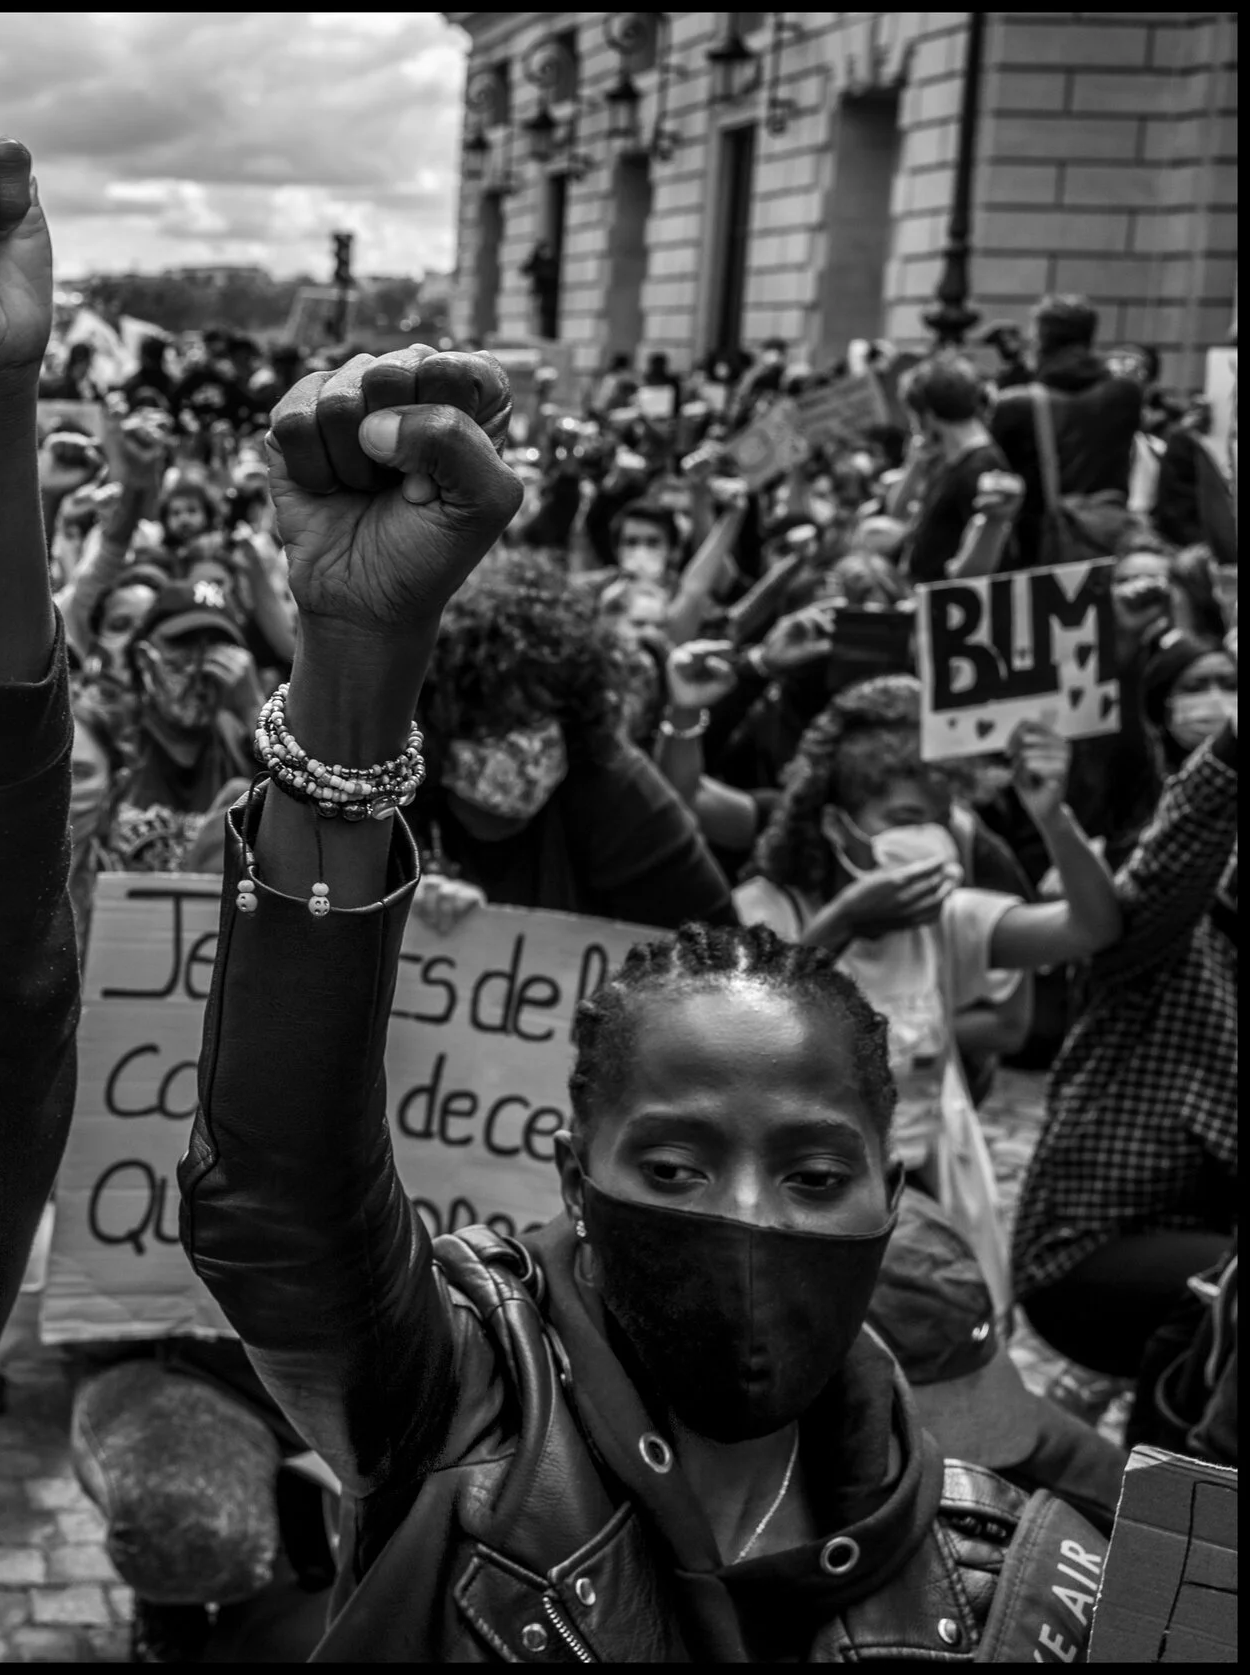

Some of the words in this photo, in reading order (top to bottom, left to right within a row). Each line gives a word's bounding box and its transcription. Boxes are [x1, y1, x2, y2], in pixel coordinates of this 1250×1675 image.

[930, 564, 1115, 712] BLM
[101, 888, 222, 999] Je
[1051, 1538, 1103, 1627] AIR
